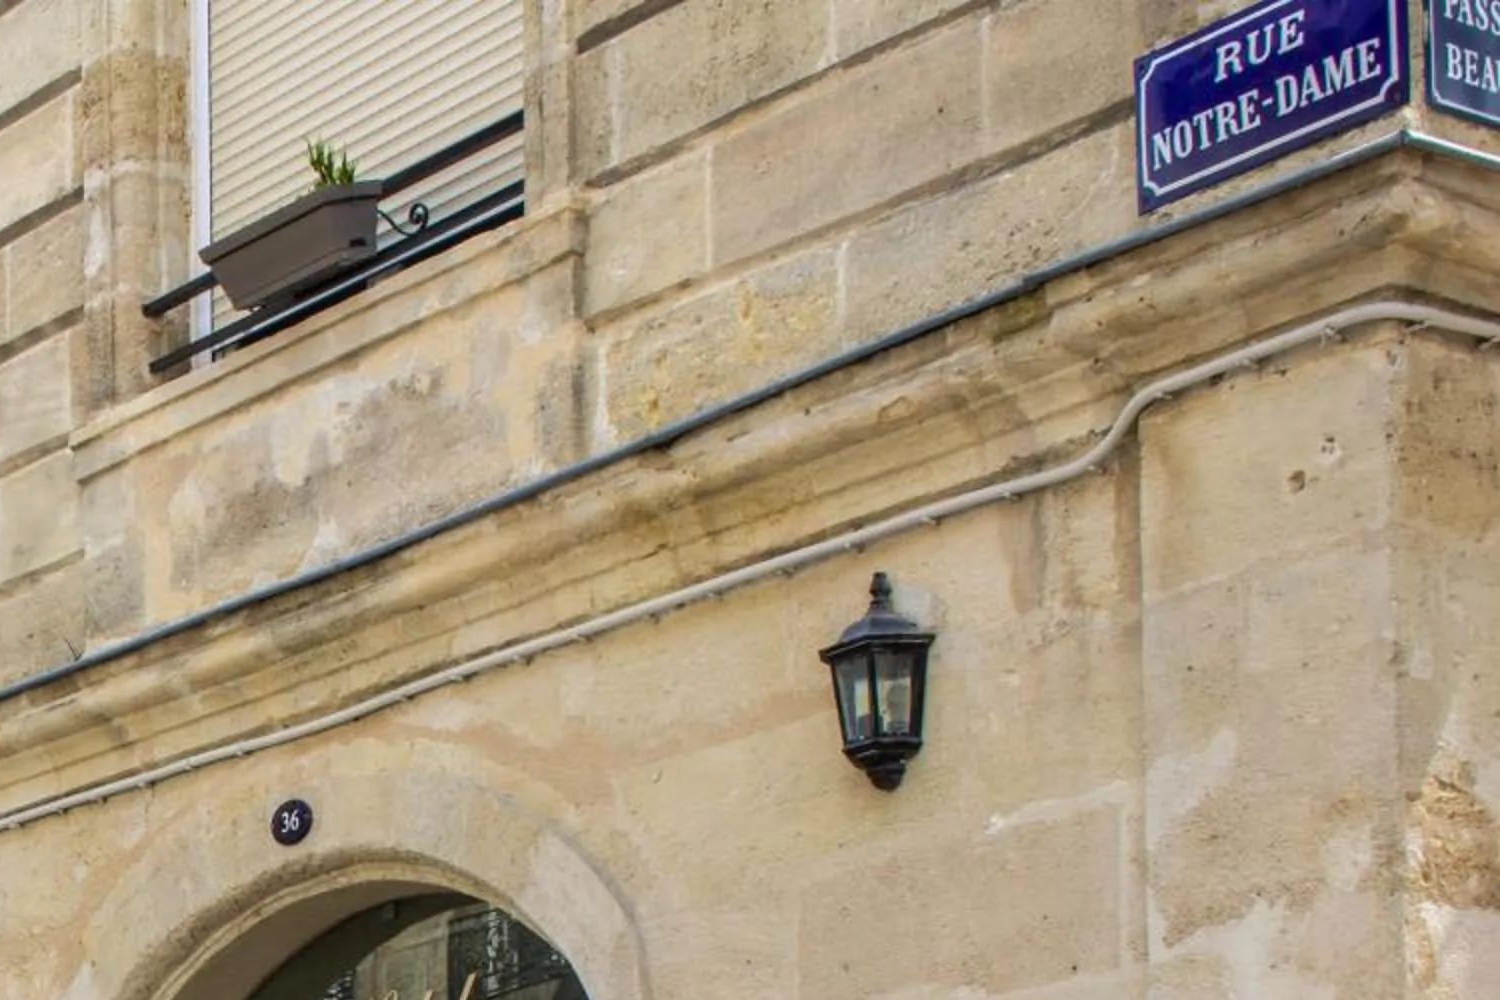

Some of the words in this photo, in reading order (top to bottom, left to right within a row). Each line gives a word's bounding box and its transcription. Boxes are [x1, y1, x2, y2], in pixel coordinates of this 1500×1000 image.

[1214, 8, 1306, 83] RUE
[1151, 37, 1382, 171] NOTRE-DAME
[281, 808, 300, 833] 36
